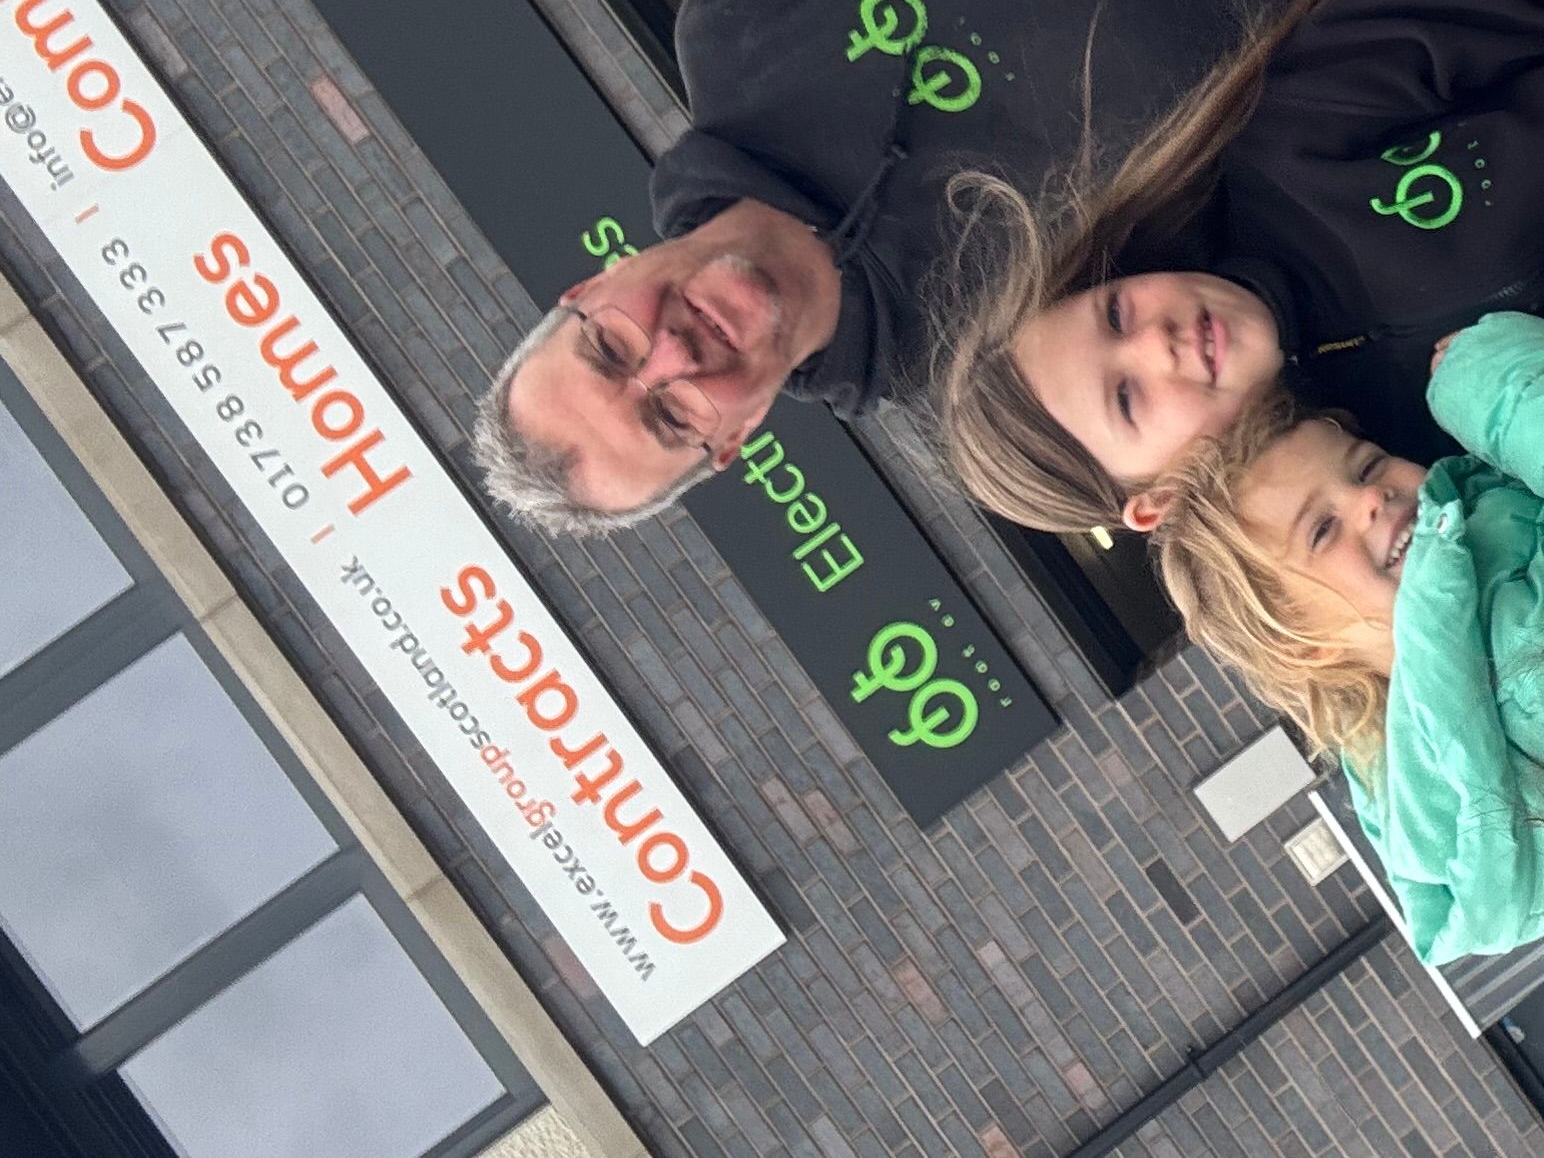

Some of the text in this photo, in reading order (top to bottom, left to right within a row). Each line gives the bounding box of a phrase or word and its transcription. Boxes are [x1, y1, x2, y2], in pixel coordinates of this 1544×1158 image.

[102, 238, 165, 315] 333
[156, 322, 221, 393] 587
[192, 233, 411, 515] Homes
[216, 394, 309, 510] 01738
[741, 432, 864, 592] Electr
[928, 599, 1012, 707] root ev
[341, 556, 655, 981] www.excelgroupscotland.co.uk
[440, 565, 724, 944] Contracts
